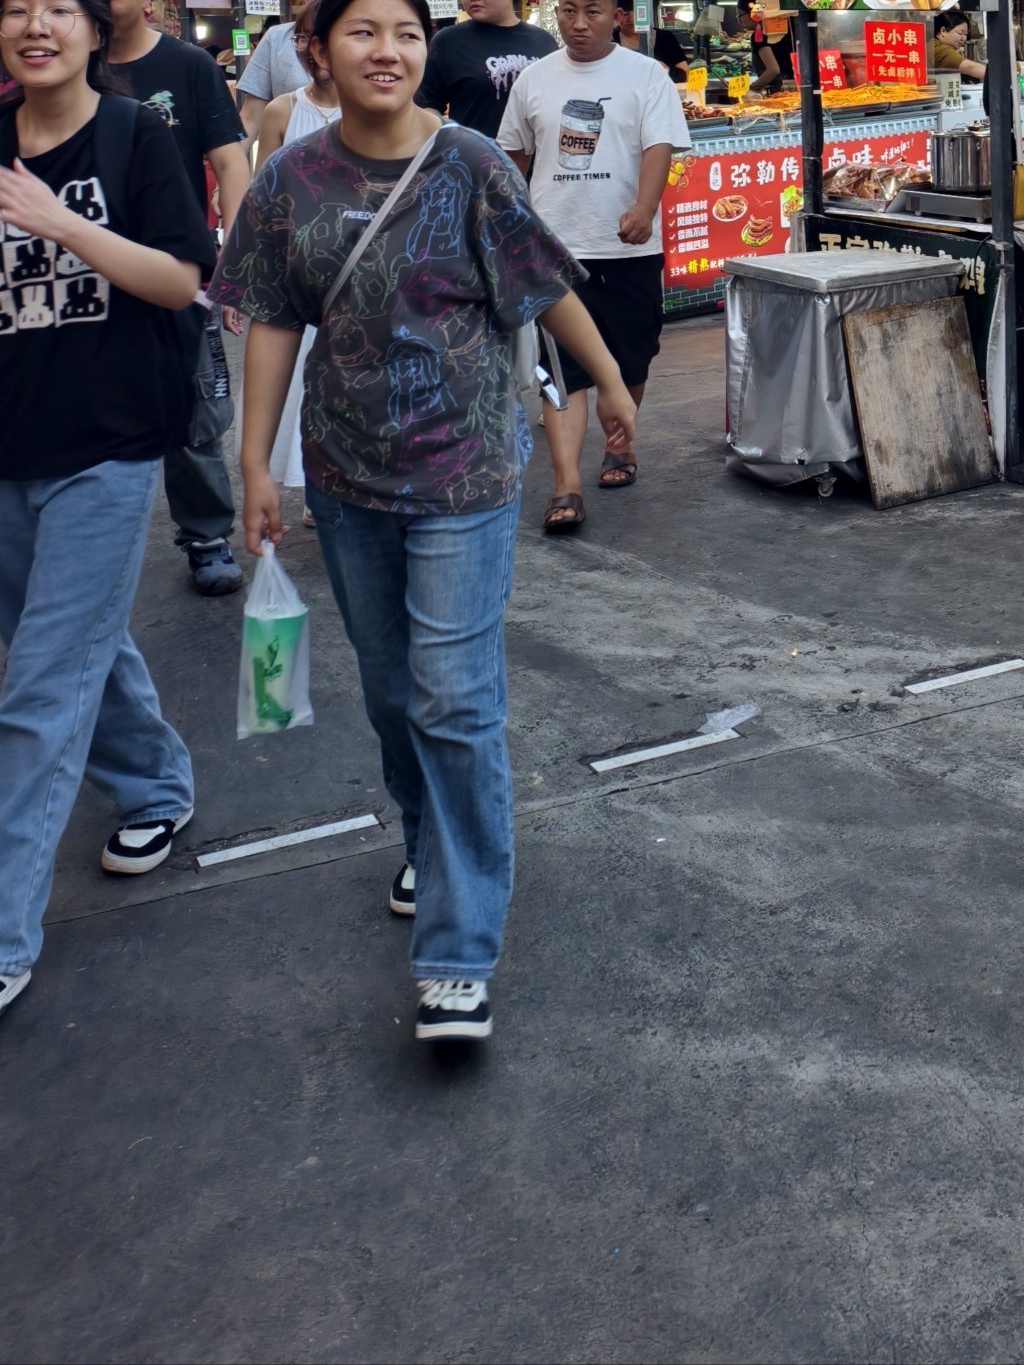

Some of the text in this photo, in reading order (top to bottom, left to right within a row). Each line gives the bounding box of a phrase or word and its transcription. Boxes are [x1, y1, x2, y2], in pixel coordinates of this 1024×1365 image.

[872, 27, 918, 46] 卤小串
[872, 48, 920, 64] 一元一串
[560, 134, 596, 153] COFFEE
[553, 171, 611, 182] COFFEE TIMES
